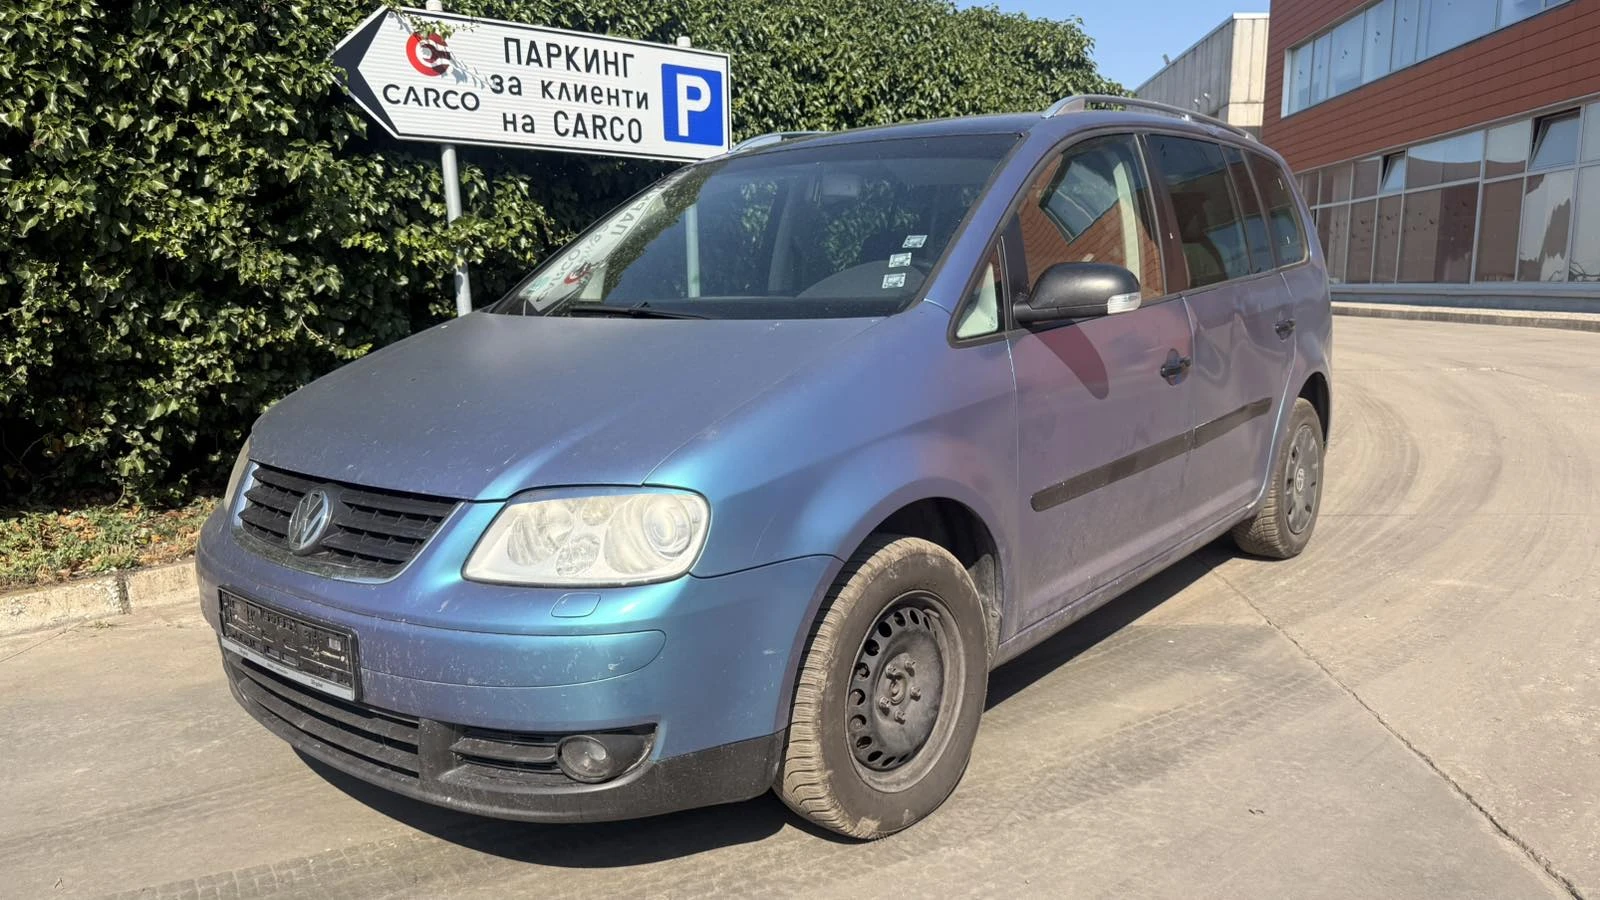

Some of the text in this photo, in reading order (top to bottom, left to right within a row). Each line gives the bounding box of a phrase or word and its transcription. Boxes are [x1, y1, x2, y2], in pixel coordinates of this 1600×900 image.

[504, 37, 635, 78] ПАРКИНГ
[382, 83, 480, 112] CARCO
[490, 74, 649, 110] за клиенти
[676, 73, 712, 137] P
[502, 110, 643, 144] на CARCO
